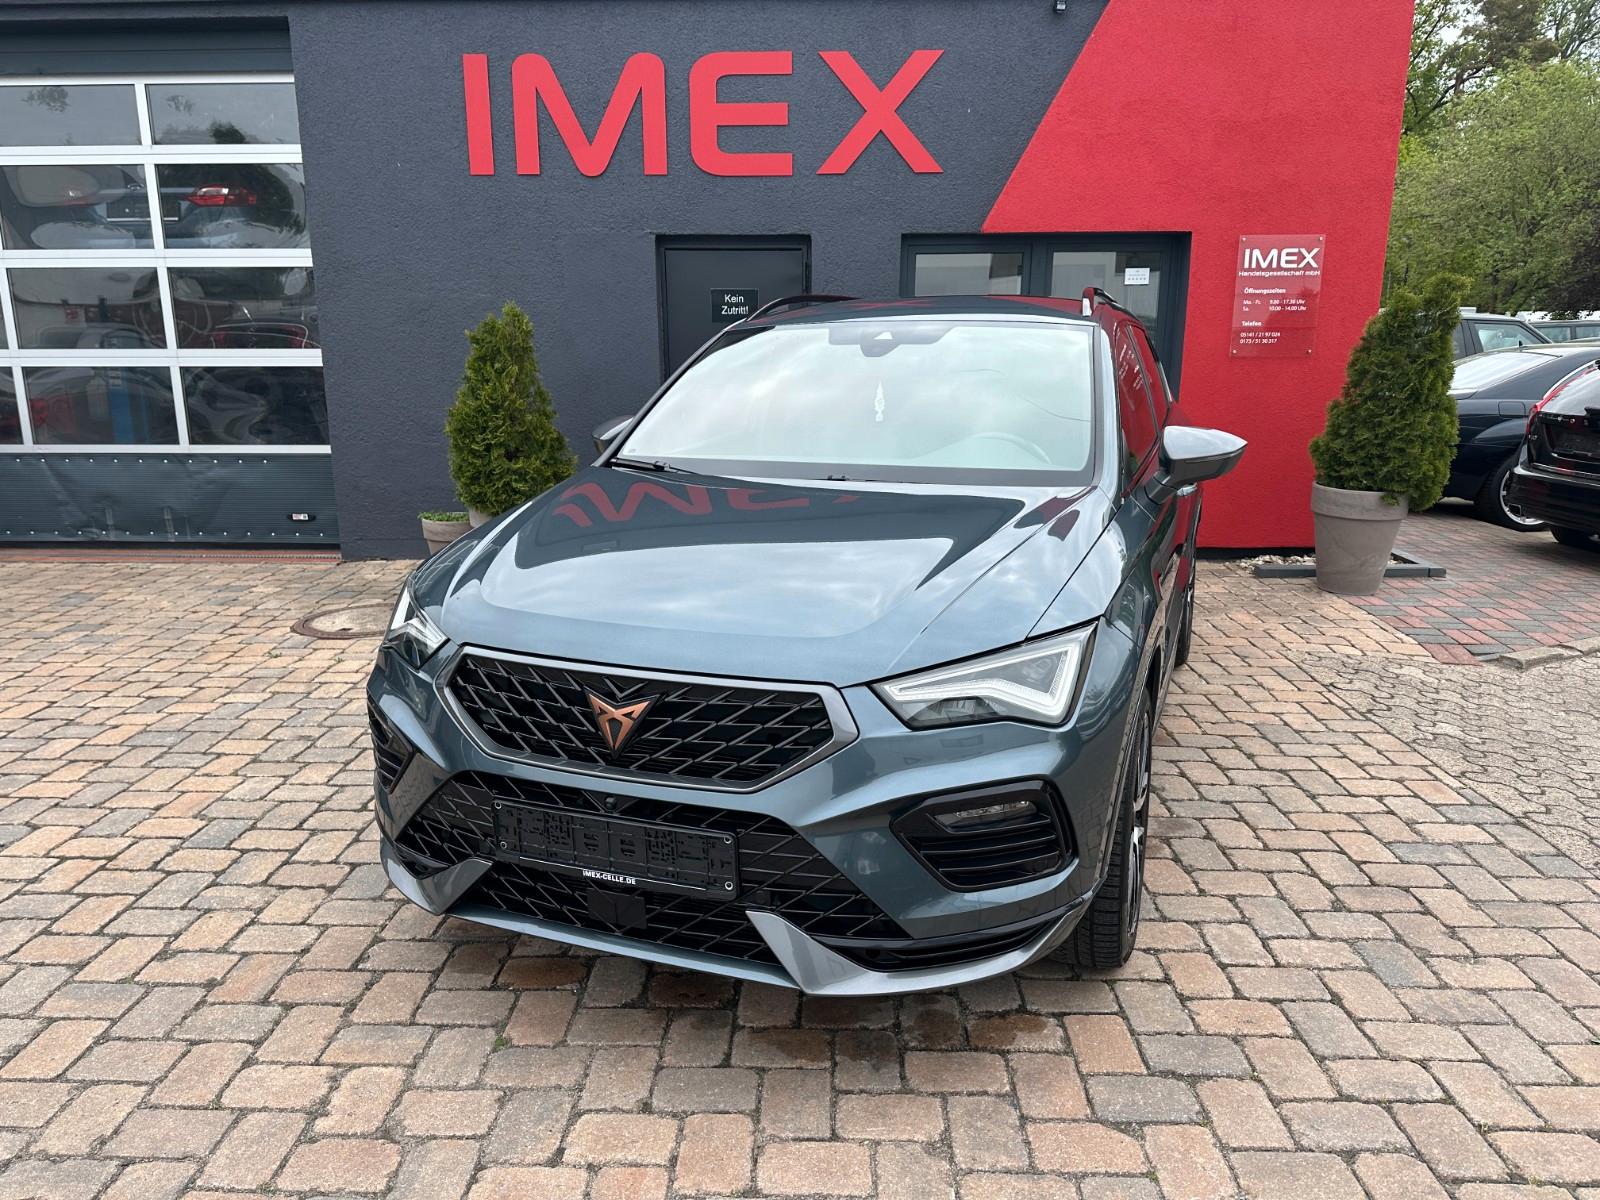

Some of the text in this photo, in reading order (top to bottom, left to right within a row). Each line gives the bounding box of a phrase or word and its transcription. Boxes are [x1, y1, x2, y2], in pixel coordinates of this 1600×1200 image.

[461, 49, 945, 177] IMEX
[1243, 247, 1321, 269] IMEX
[1238, 270, 1304, 278] Handelsgesellschaft
[1244, 287, 1286, 295] Öffnungszeiten
[724, 293, 744, 303] Kein
[721, 305, 749, 315] Zutritt!
[582, 869, 636, 885] IMEX-CELLE.DE
